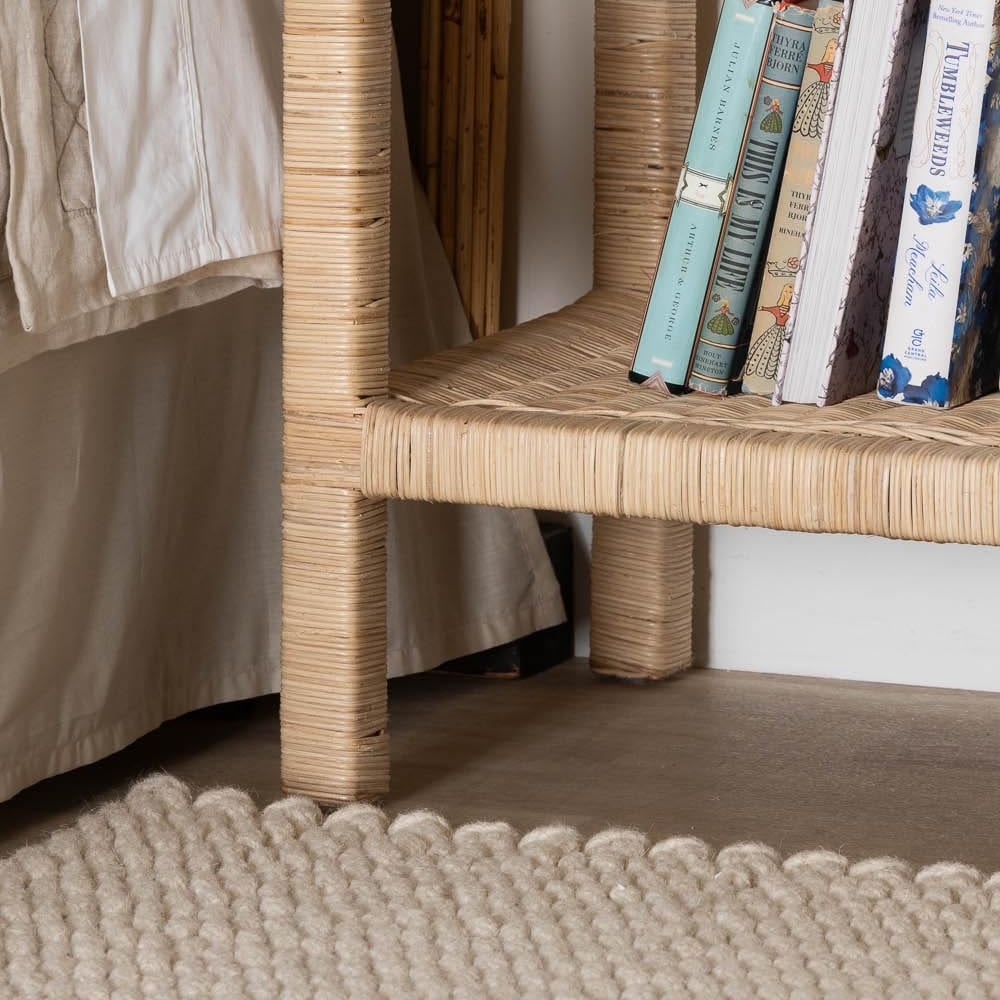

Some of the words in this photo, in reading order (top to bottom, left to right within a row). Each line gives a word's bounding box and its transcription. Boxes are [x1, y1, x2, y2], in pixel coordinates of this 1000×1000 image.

[723, 42, 740, 93] JULIAN
[709, 99, 727, 151] BARNES
[929, 41, 970, 177] TUMBLEWEEDS
[742, 139, 779, 184] THIS
[735, 187, 766, 210] IS
[788, 212, 808, 222] BJOR
[789, 201, 809, 212] FERR
[791, 190, 811, 201] THYR
[680, 224, 697, 273] ARTHUR
[727, 213, 760, 245] MY
[716, 247, 752, 292] LIFE
[904, 233, 929, 307] Meacham
[925, 263, 949, 300] Leila
[665, 292, 681, 341] GEORGE
